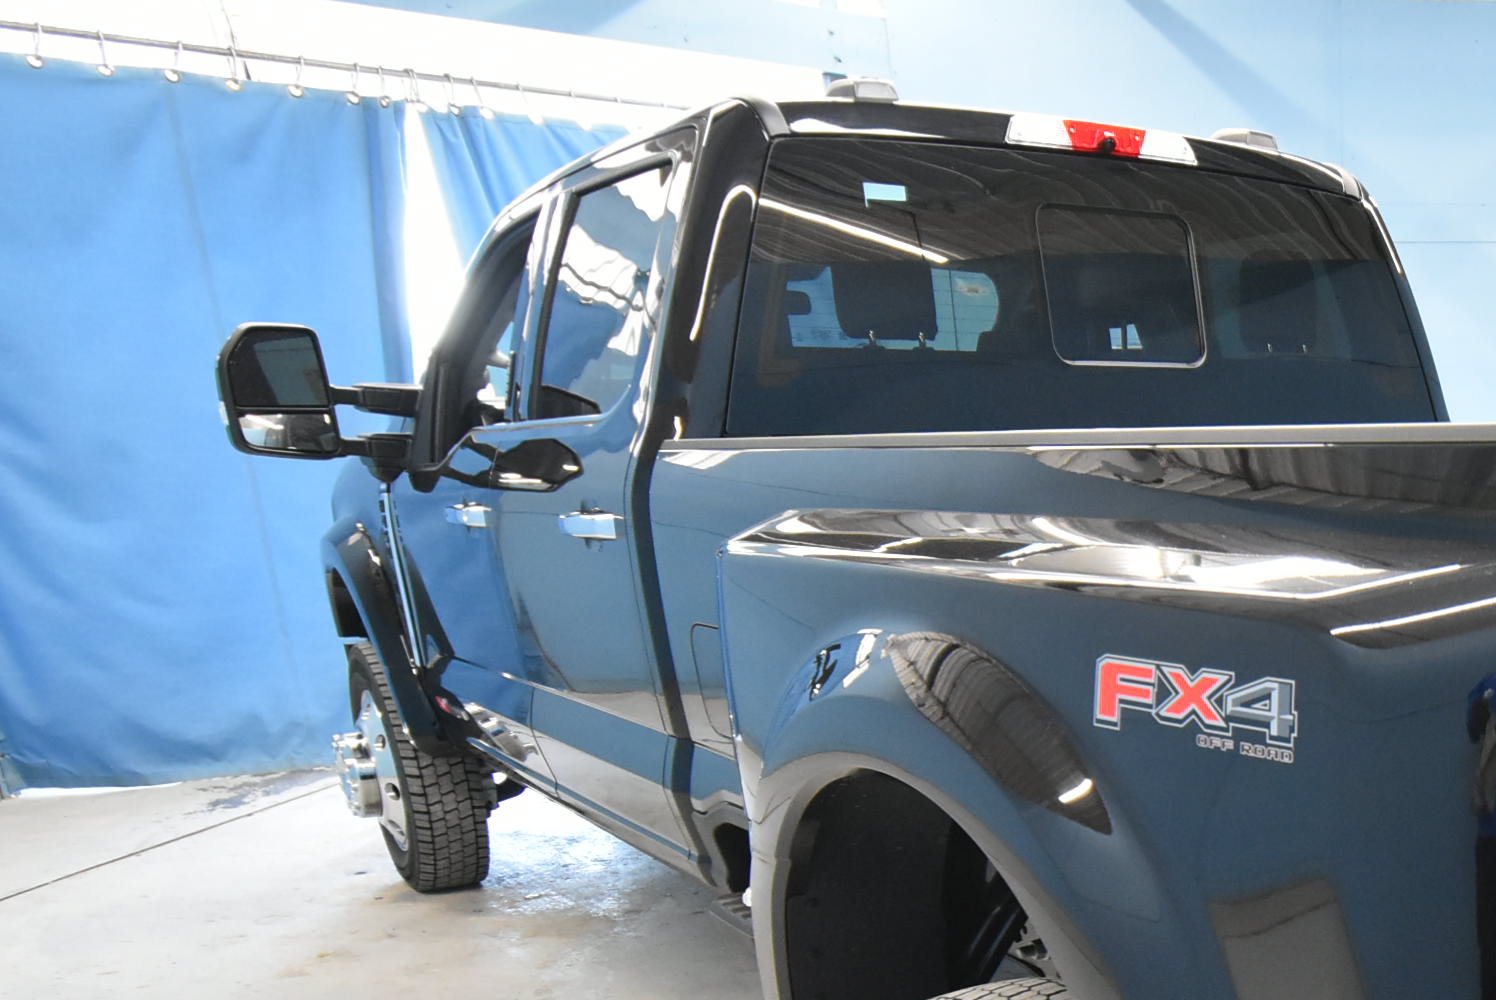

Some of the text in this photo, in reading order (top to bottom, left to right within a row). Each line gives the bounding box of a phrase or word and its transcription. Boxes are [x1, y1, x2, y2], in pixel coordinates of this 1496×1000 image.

[1093, 653, 1298, 747] FX4
[1196, 734, 1294, 764] OFF ROAD
